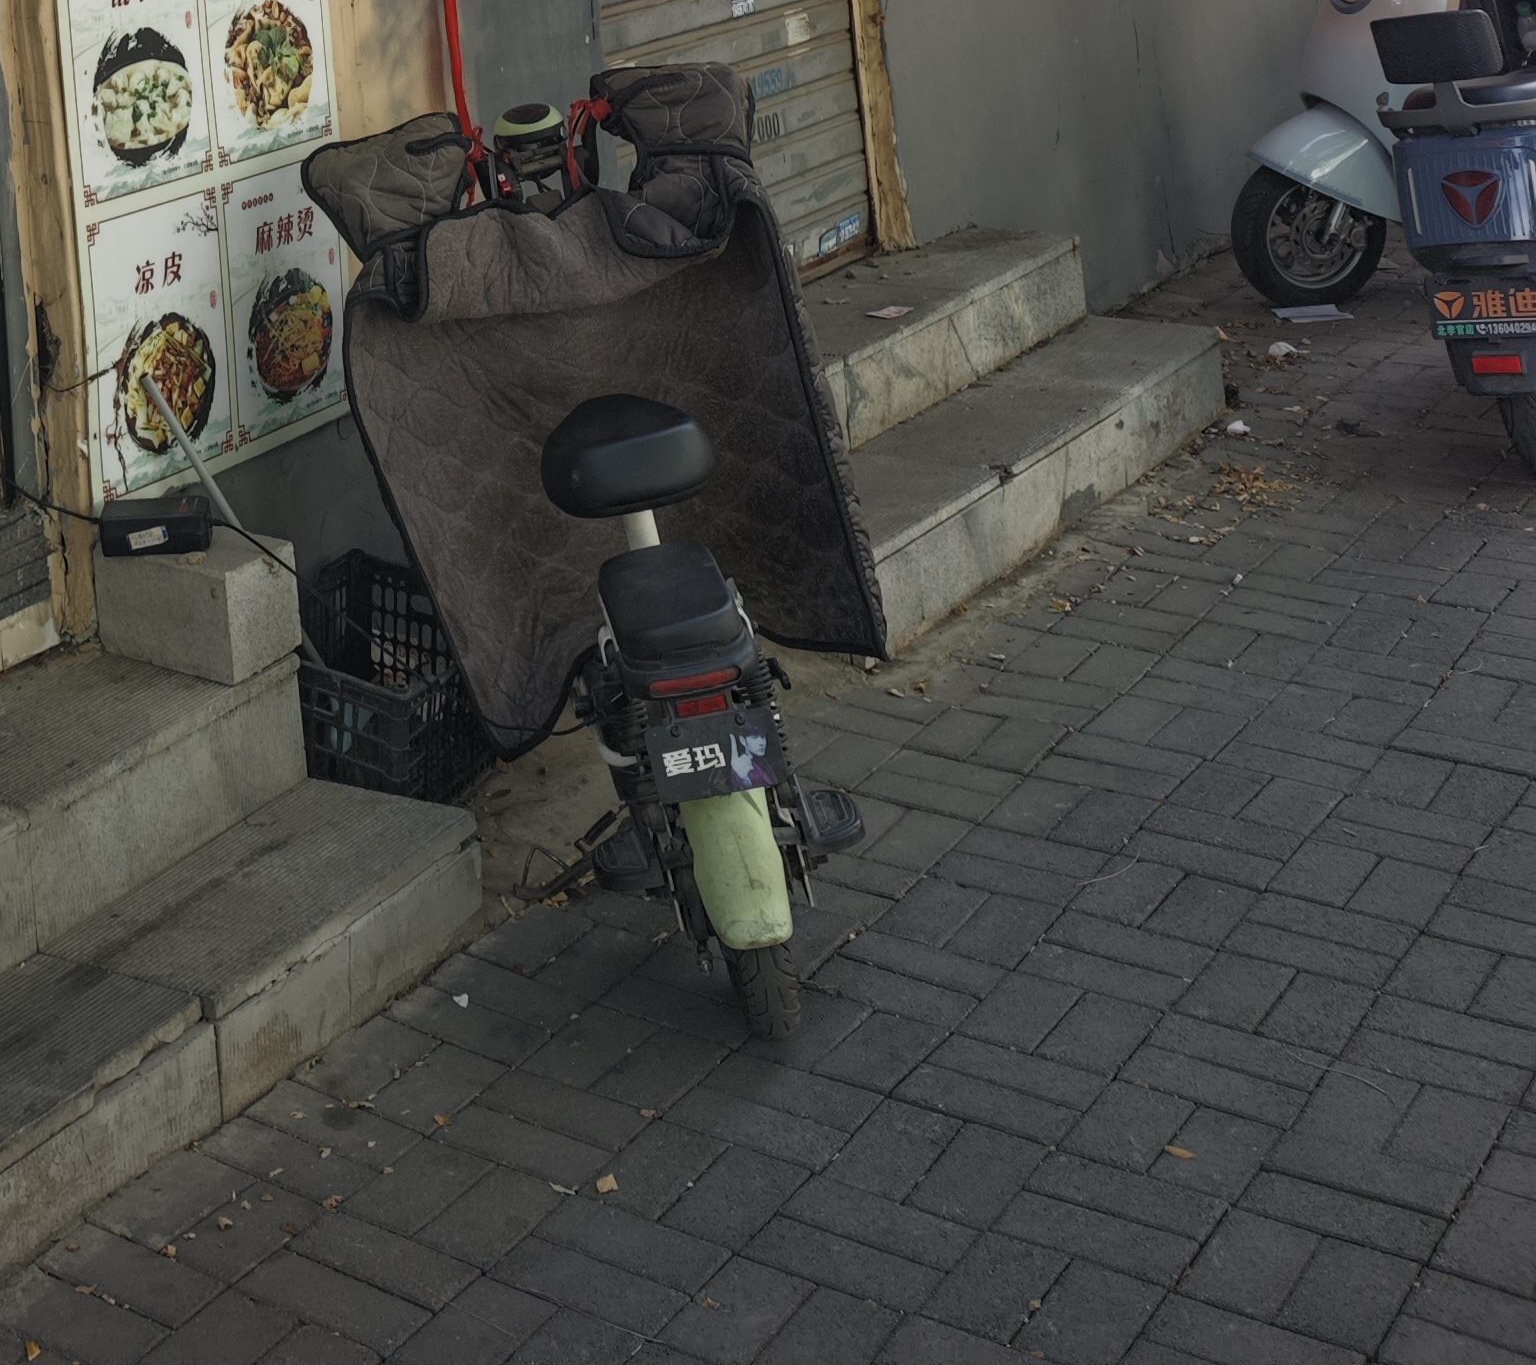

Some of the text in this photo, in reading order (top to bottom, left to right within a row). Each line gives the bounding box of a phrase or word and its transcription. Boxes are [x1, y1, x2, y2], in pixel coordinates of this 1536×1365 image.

[255, 207, 314, 256] 麻辣烫
[134, 250, 184, 295] 凉皮
[1471, 287, 1536, 318] 雅迪
[662, 743, 727, 777] 爱玛
